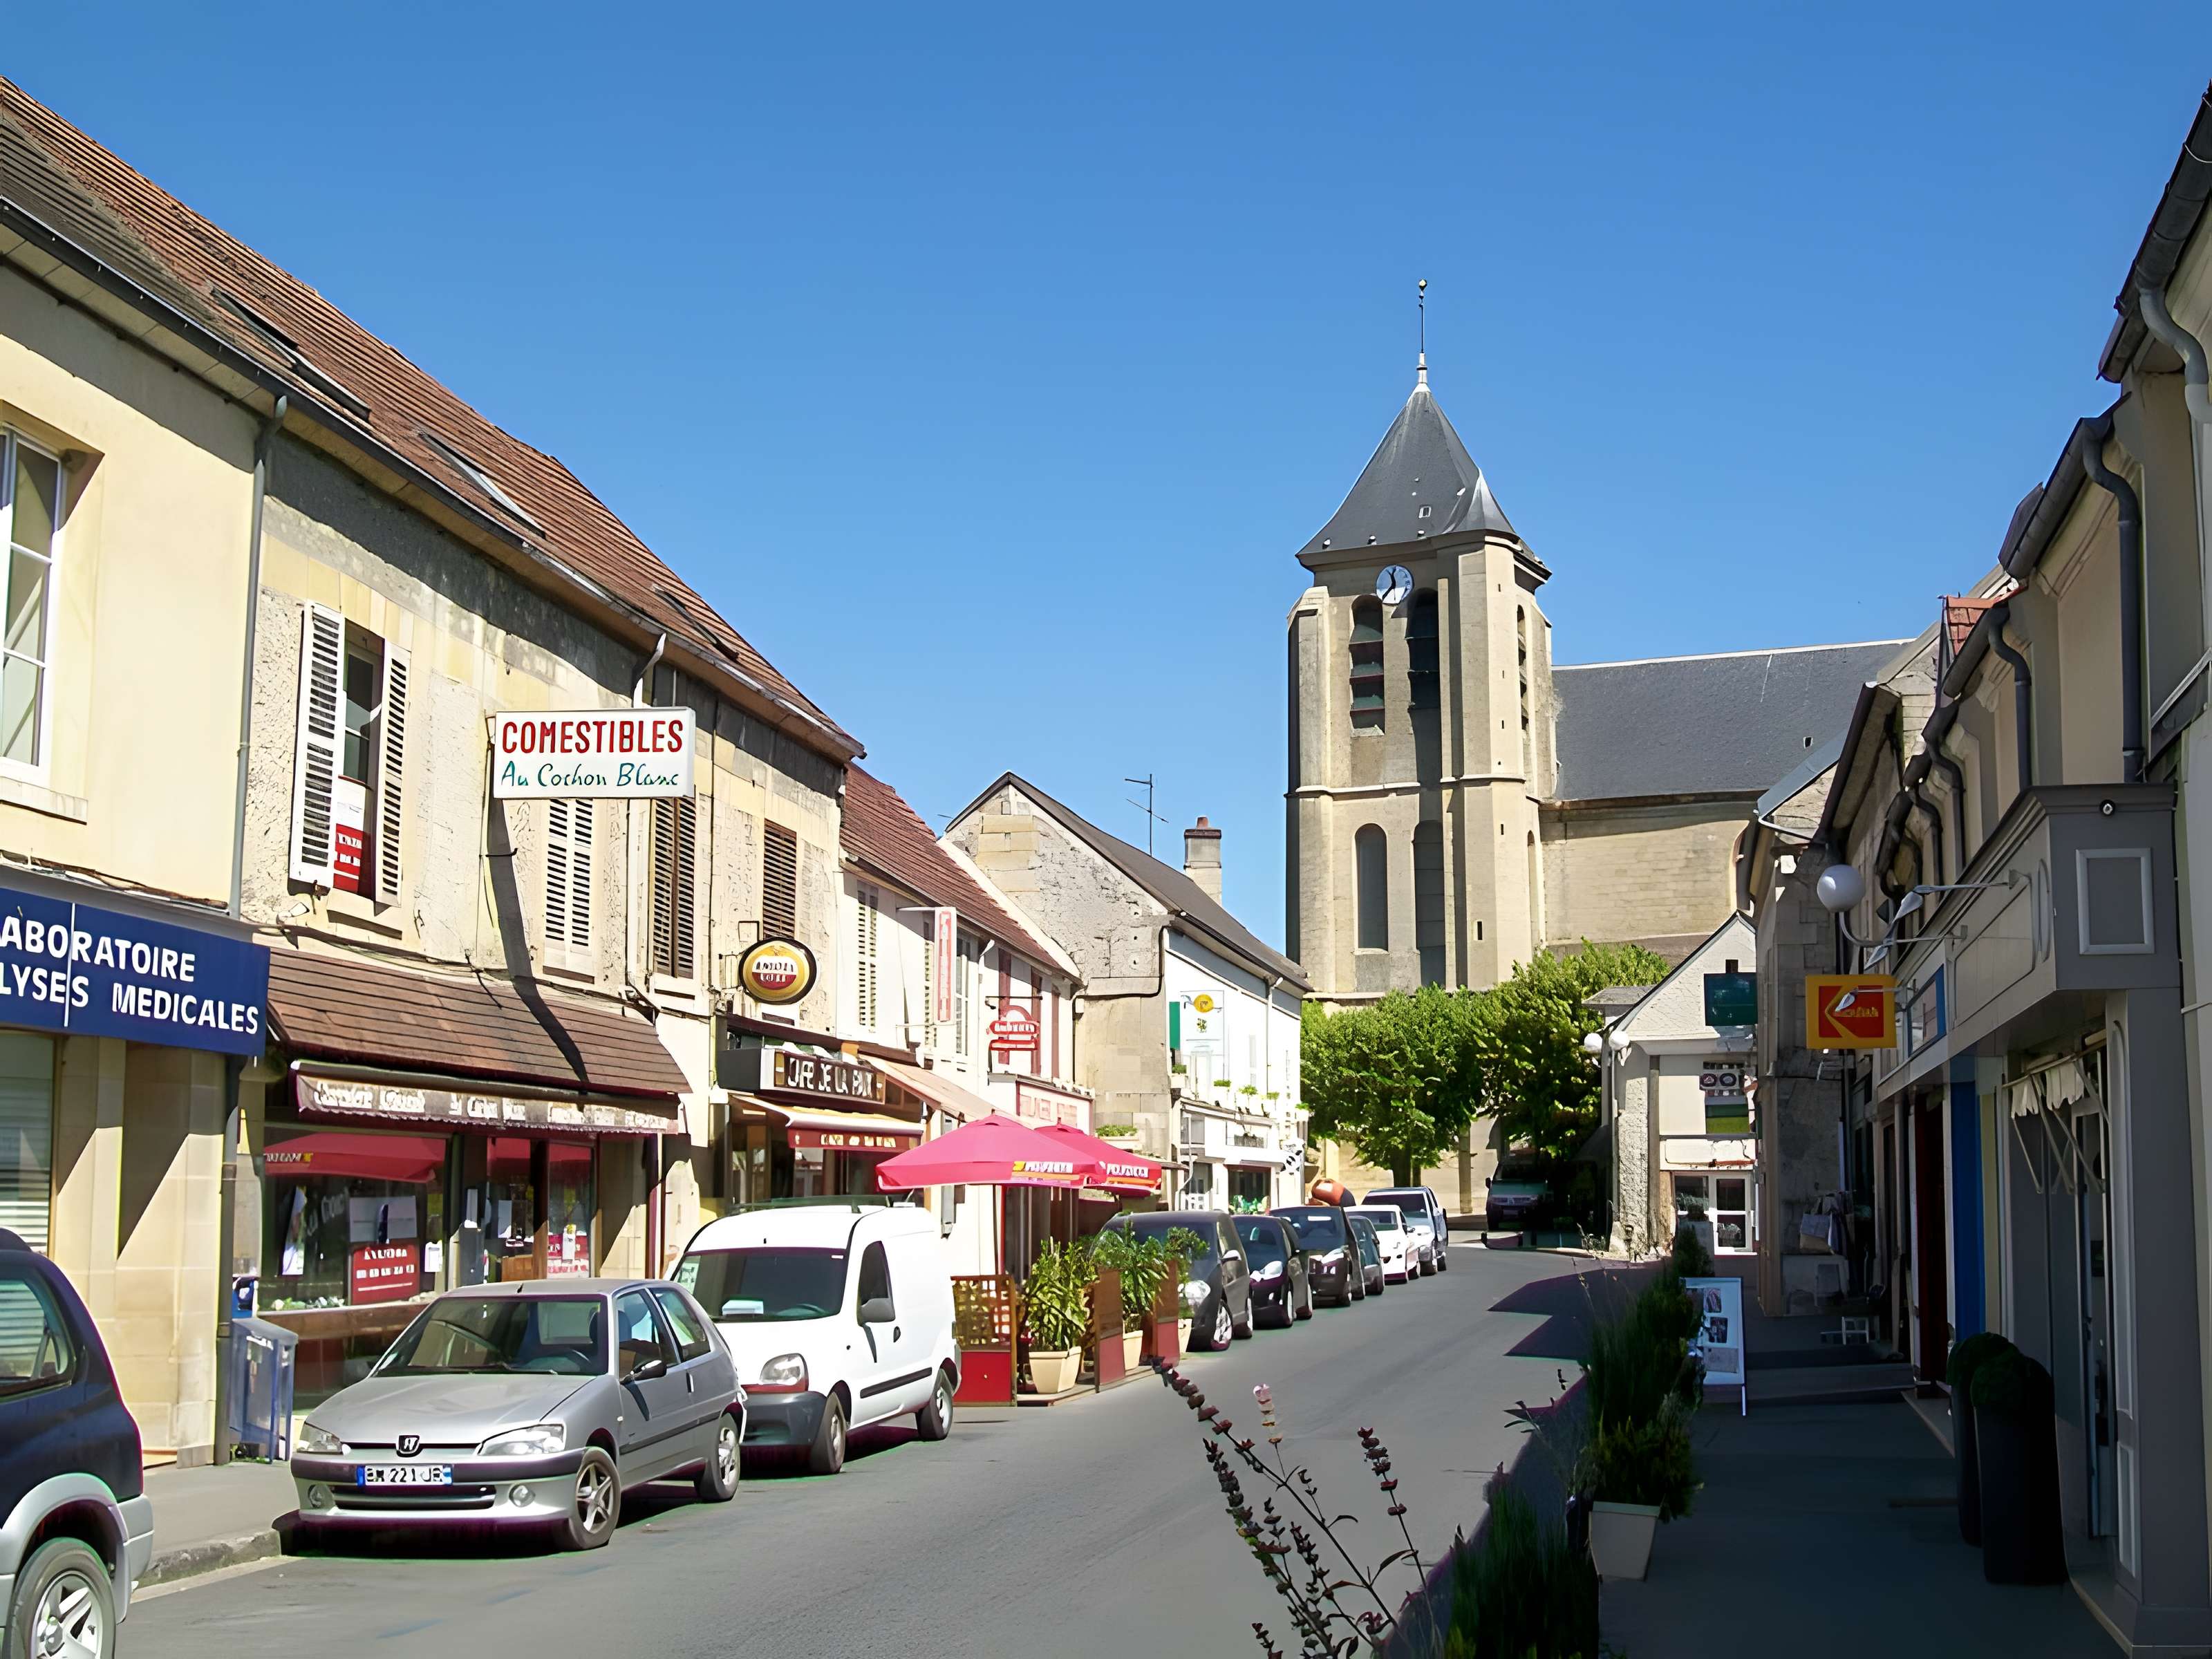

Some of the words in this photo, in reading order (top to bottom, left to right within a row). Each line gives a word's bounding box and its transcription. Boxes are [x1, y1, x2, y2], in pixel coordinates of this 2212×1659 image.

[503, 720, 684, 753] COMESTIBLES
[501, 760, 529, 787] Au
[538, 763, 607, 787] Cochon
[617, 762, 679, 787] Blanc
[0, 915, 196, 982] ABORATOIRE
[112, 983, 259, 1035] MEDICALES
